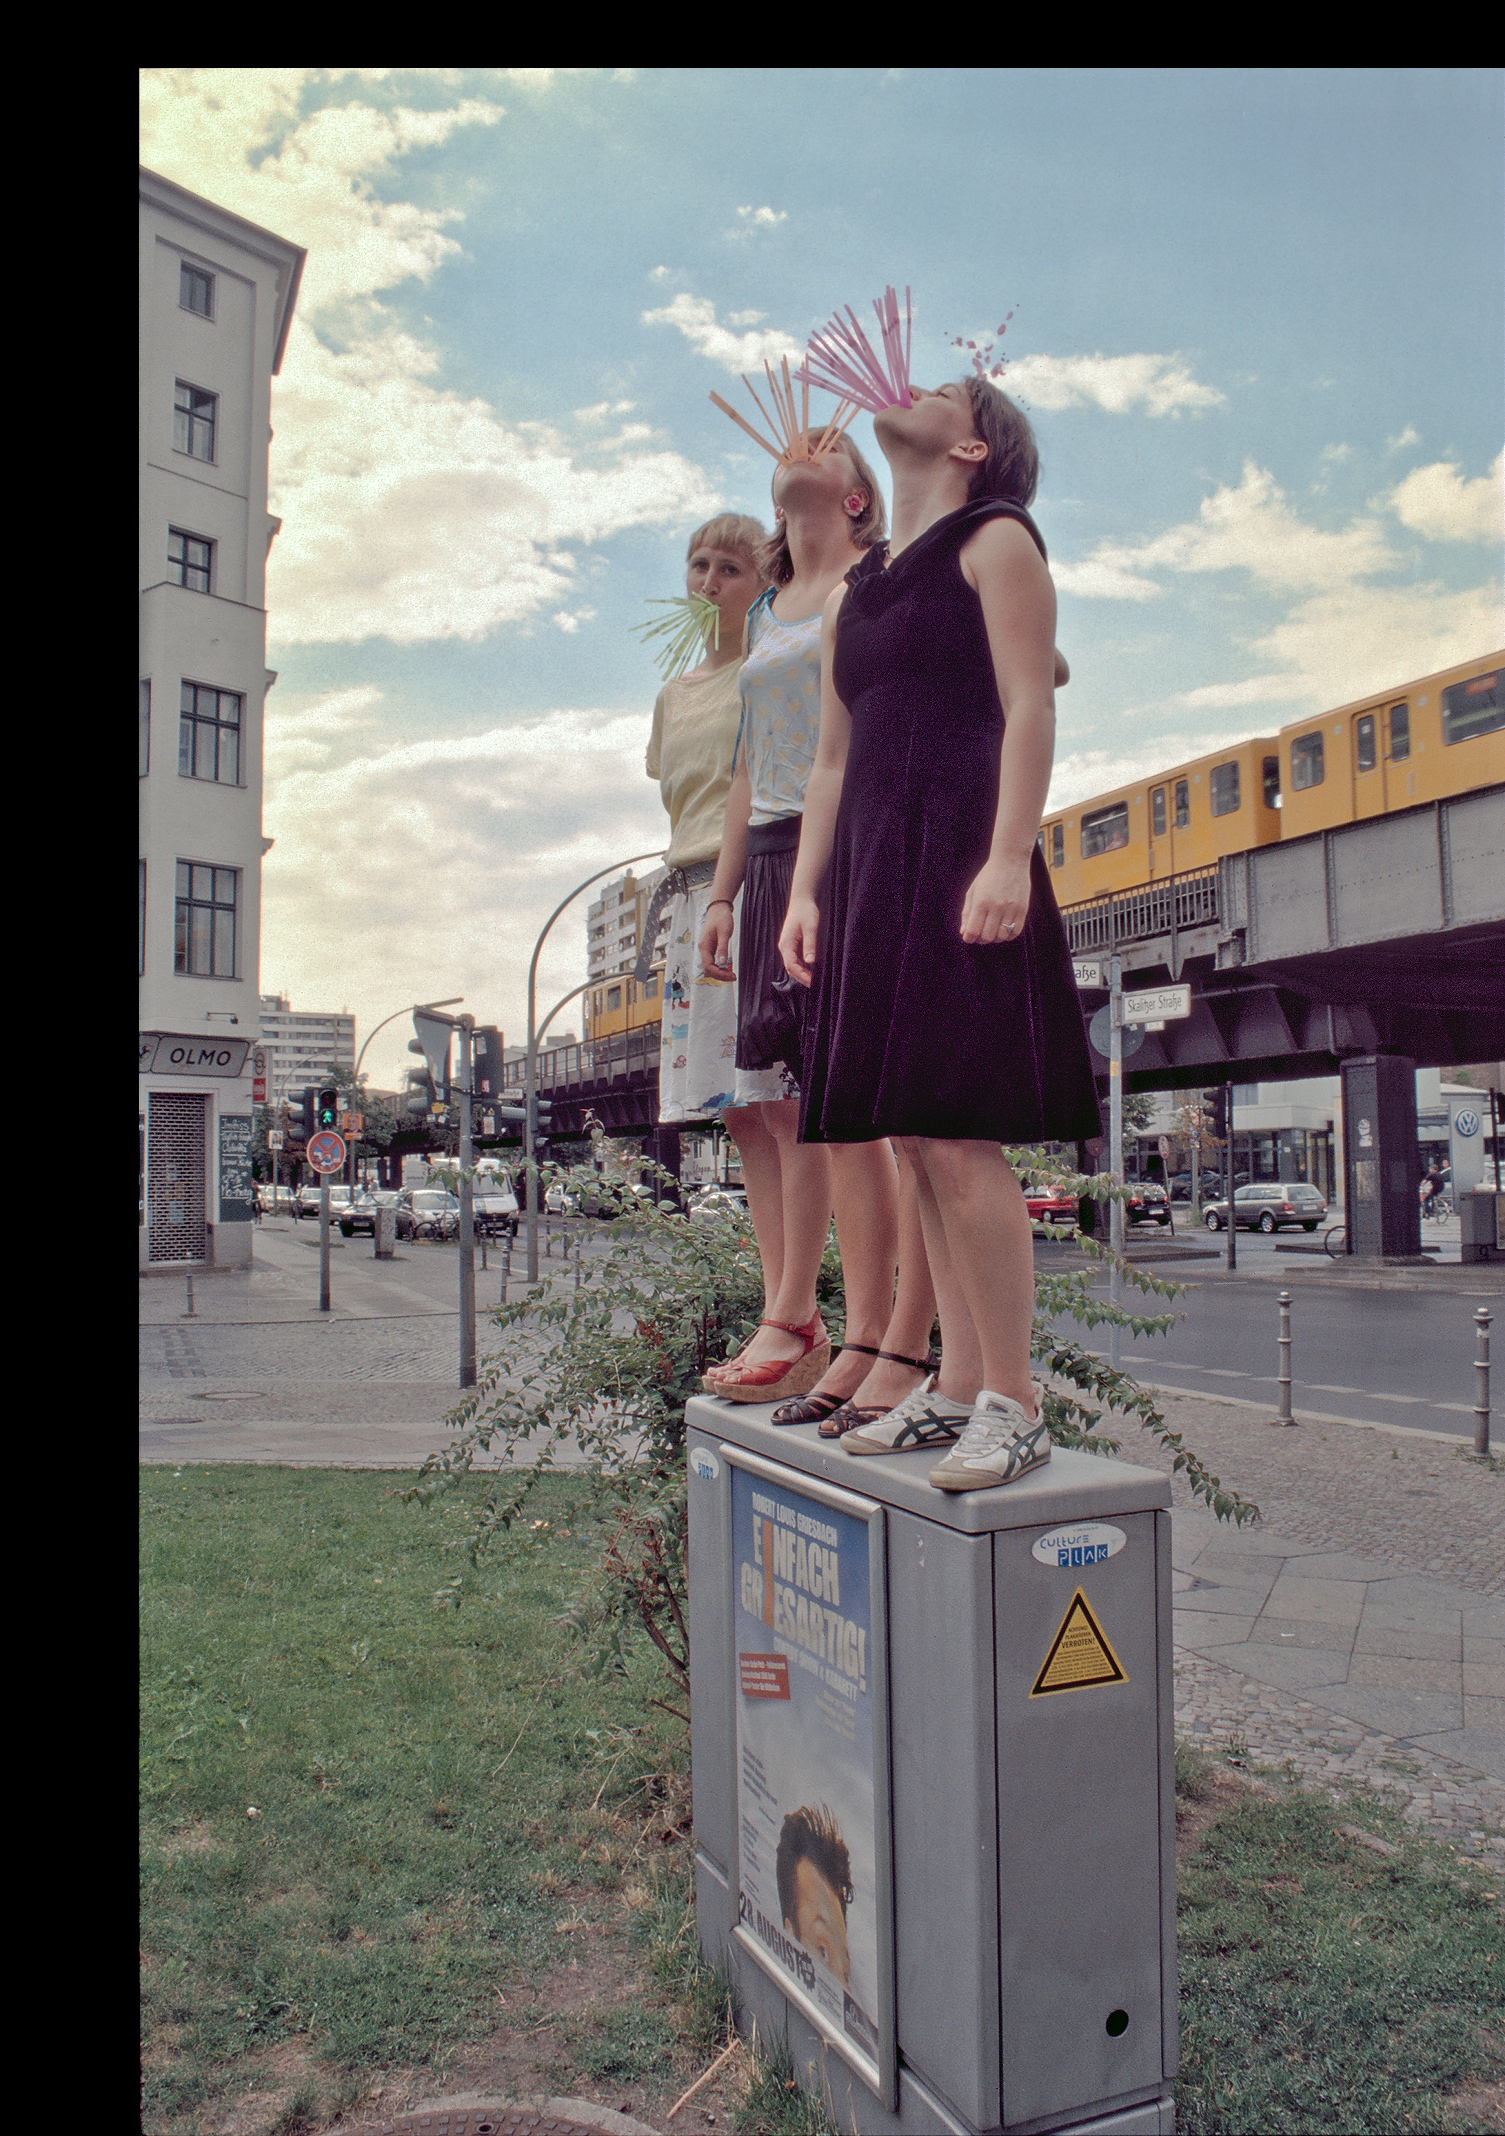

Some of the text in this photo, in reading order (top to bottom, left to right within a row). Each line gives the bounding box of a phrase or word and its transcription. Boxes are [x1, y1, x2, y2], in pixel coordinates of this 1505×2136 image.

[1074, 965, 1097, 982] aße
[1127, 993, 1182, 1014] Skalitzer Straße
[170, 1047, 232, 1066] OLMO
[752, 1514, 840, 1607] EINFACH
[1061, 1637, 1096, 1649] VERBOTEN!
[756, 1909, 802, 1980] AUGUST
